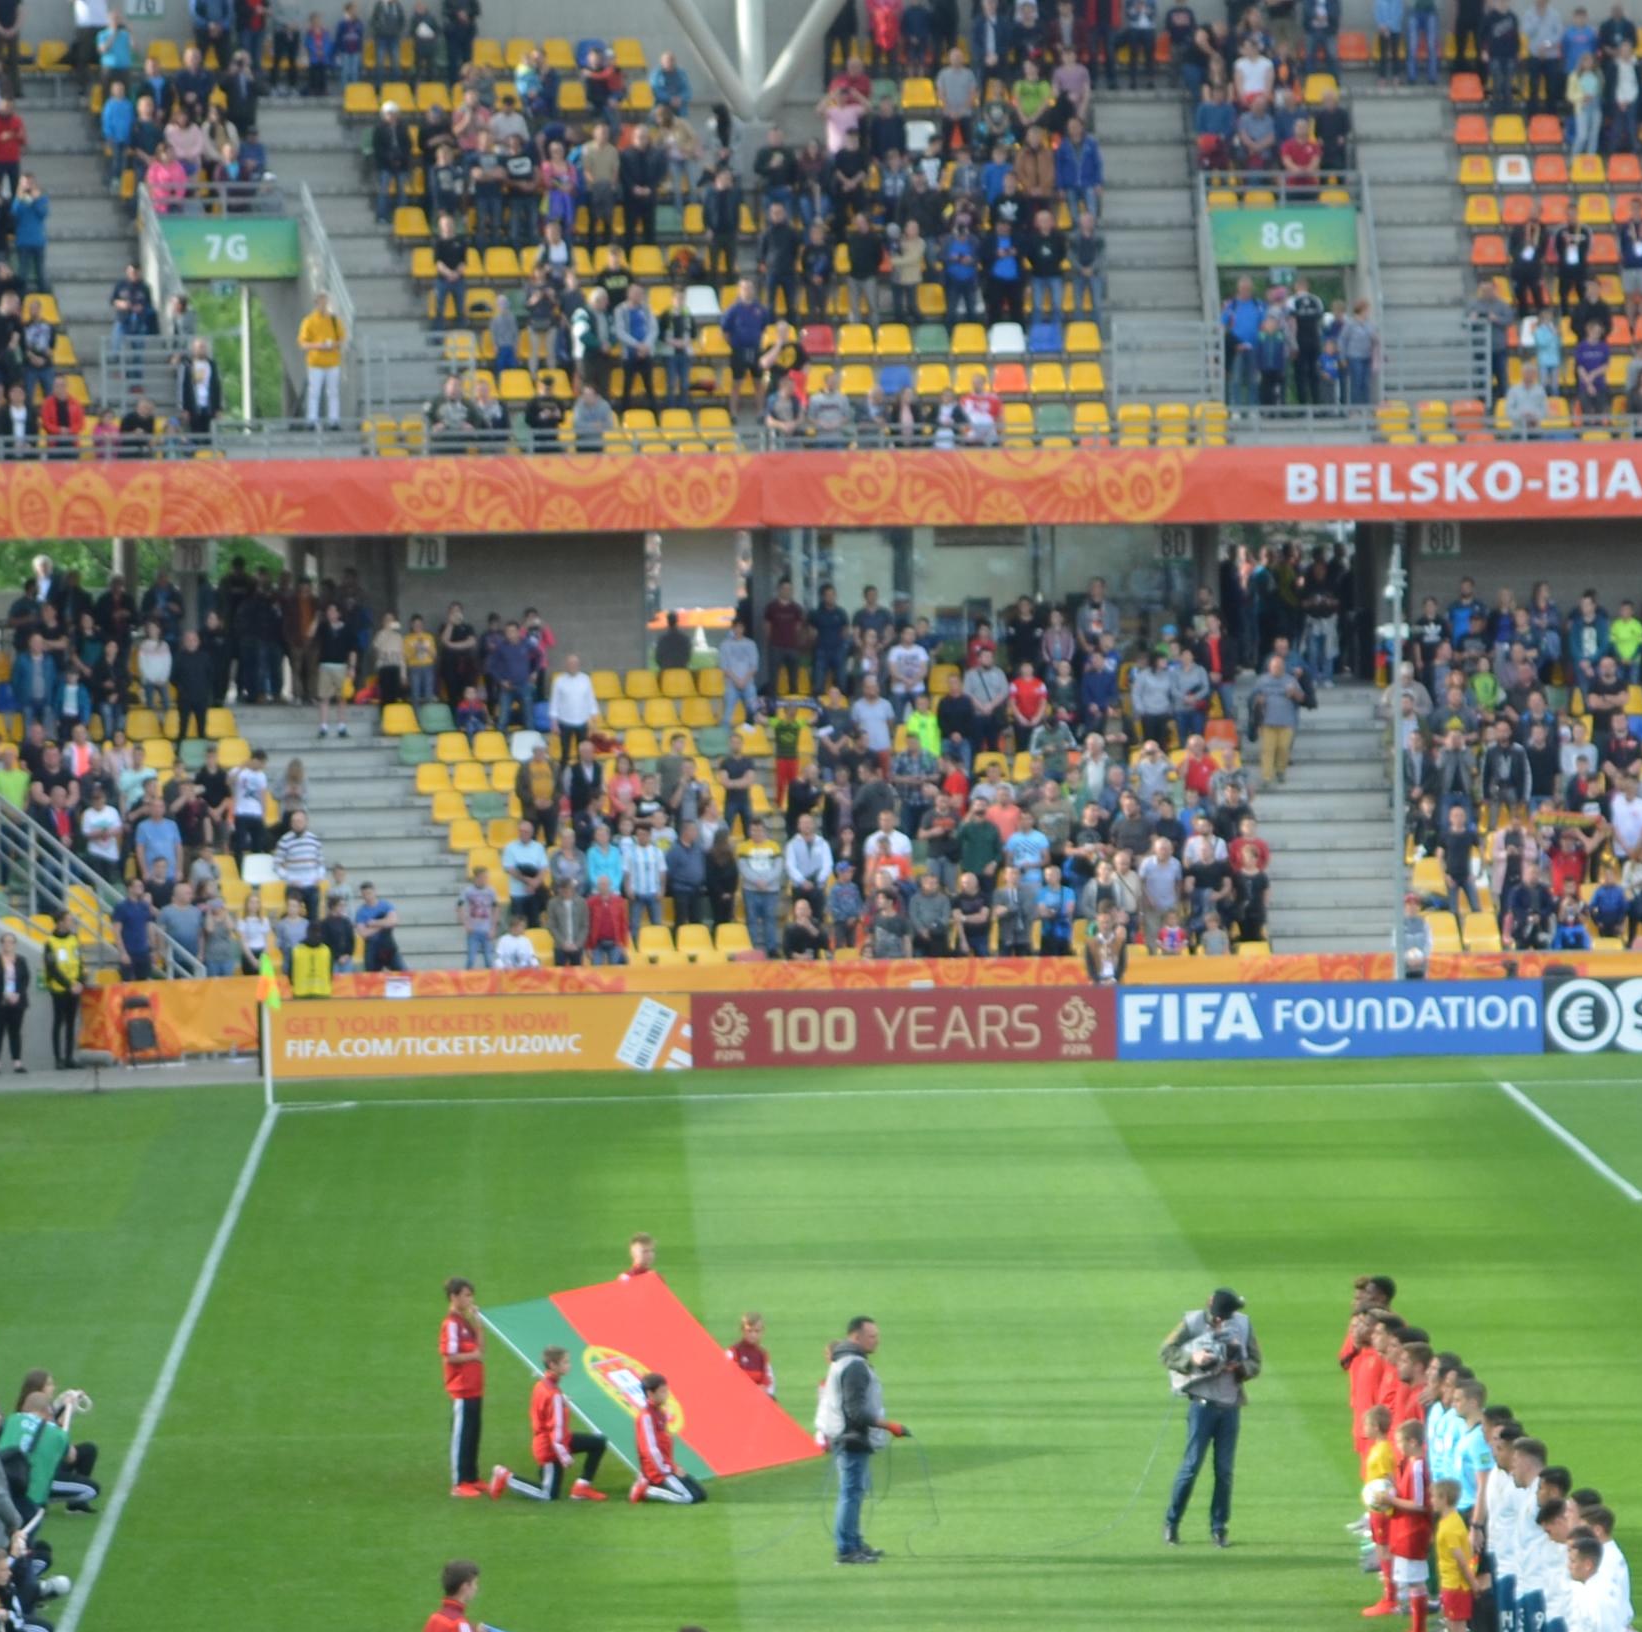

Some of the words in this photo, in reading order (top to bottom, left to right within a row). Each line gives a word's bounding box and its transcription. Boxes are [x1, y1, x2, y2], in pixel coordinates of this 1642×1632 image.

[205, 234, 248, 262] 7G
[1261, 221, 1304, 249] 8G
[285, 1017, 328, 1036] GET
[337, 1016, 400, 1034] YOUR
[408, 1014, 493, 1033] TICKETS
[503, 1012, 570, 1032] NOW!
[764, 1006, 856, 1053] 100
[874, 1004, 1042, 1051] YEARS
[1123, 992, 1263, 1043] FIFA
[285, 1033, 582, 1059] FIFA.COM/TICKETS/U20WC
